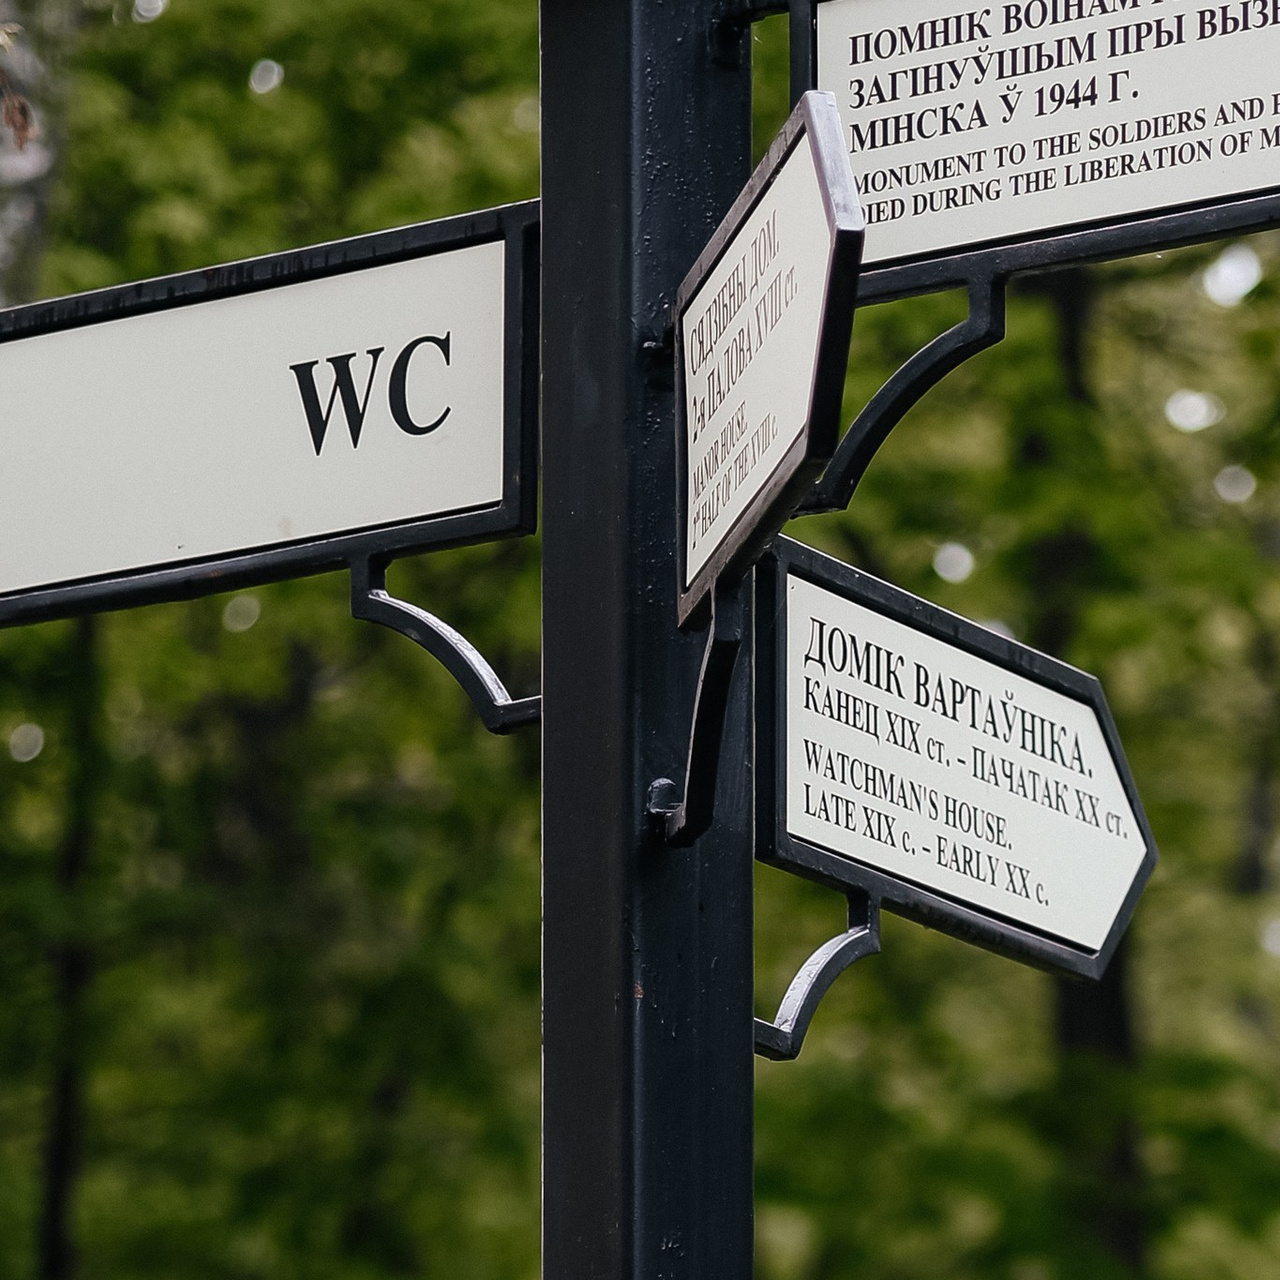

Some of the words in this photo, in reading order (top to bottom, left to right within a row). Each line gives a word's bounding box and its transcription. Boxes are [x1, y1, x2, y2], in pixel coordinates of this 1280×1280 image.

[849, 8, 992, 66] ПОМНІК
[849, 31, 1097, 109] ЗАГІНУЎШЫМ
[1107, 14, 1187, 58] ПРЫ
[849, 99, 989, 153] МІНСКА
[999, 83, 1024, 123] Ў
[1034, 75, 1098, 117] 1944
[1108, 70, 1139, 103] Г.
[854, 150, 987, 195] MONUMENT
[994, 143, 1026, 168] TO
[1033, 132, 1081, 161] THE
[1088, 108, 1206, 151] SOLDIERS
[1214, 97, 1265, 127] AND
[861, 198, 906, 225] IED
[912, 179, 1001, 217] DURING
[1009, 168, 1056, 197] THE
[1064, 138, 1213, 187] LIBERATION
[1220, 131, 1253, 157] OF
[750, 209, 779, 304] ДОМ.
[289, 331, 452, 457] WC
[707, 317, 753, 421] ПАЛОВА
[693, 439, 719, 504] MANOR
[702, 482, 720, 538] HALF
[722, 467, 732, 507] OF
[734, 443, 749, 491] THE
[804, 617, 905, 700] ДОМІК
[914, 662, 1093, 779] ВАРТАЎНІКА.
[804, 676, 880, 746] КАНЕЦ
[972, 746, 1069, 816] ПАЧАТАК
[803, 739, 938, 821] WATCHMAN'S
[944, 795, 1012, 850] HOUSE.
[804, 783, 857, 832] LATE
[862, 806, 896, 848] XIX
[936, 835, 999, 887] EARLY
[1005, 862, 1031, 900] XX
